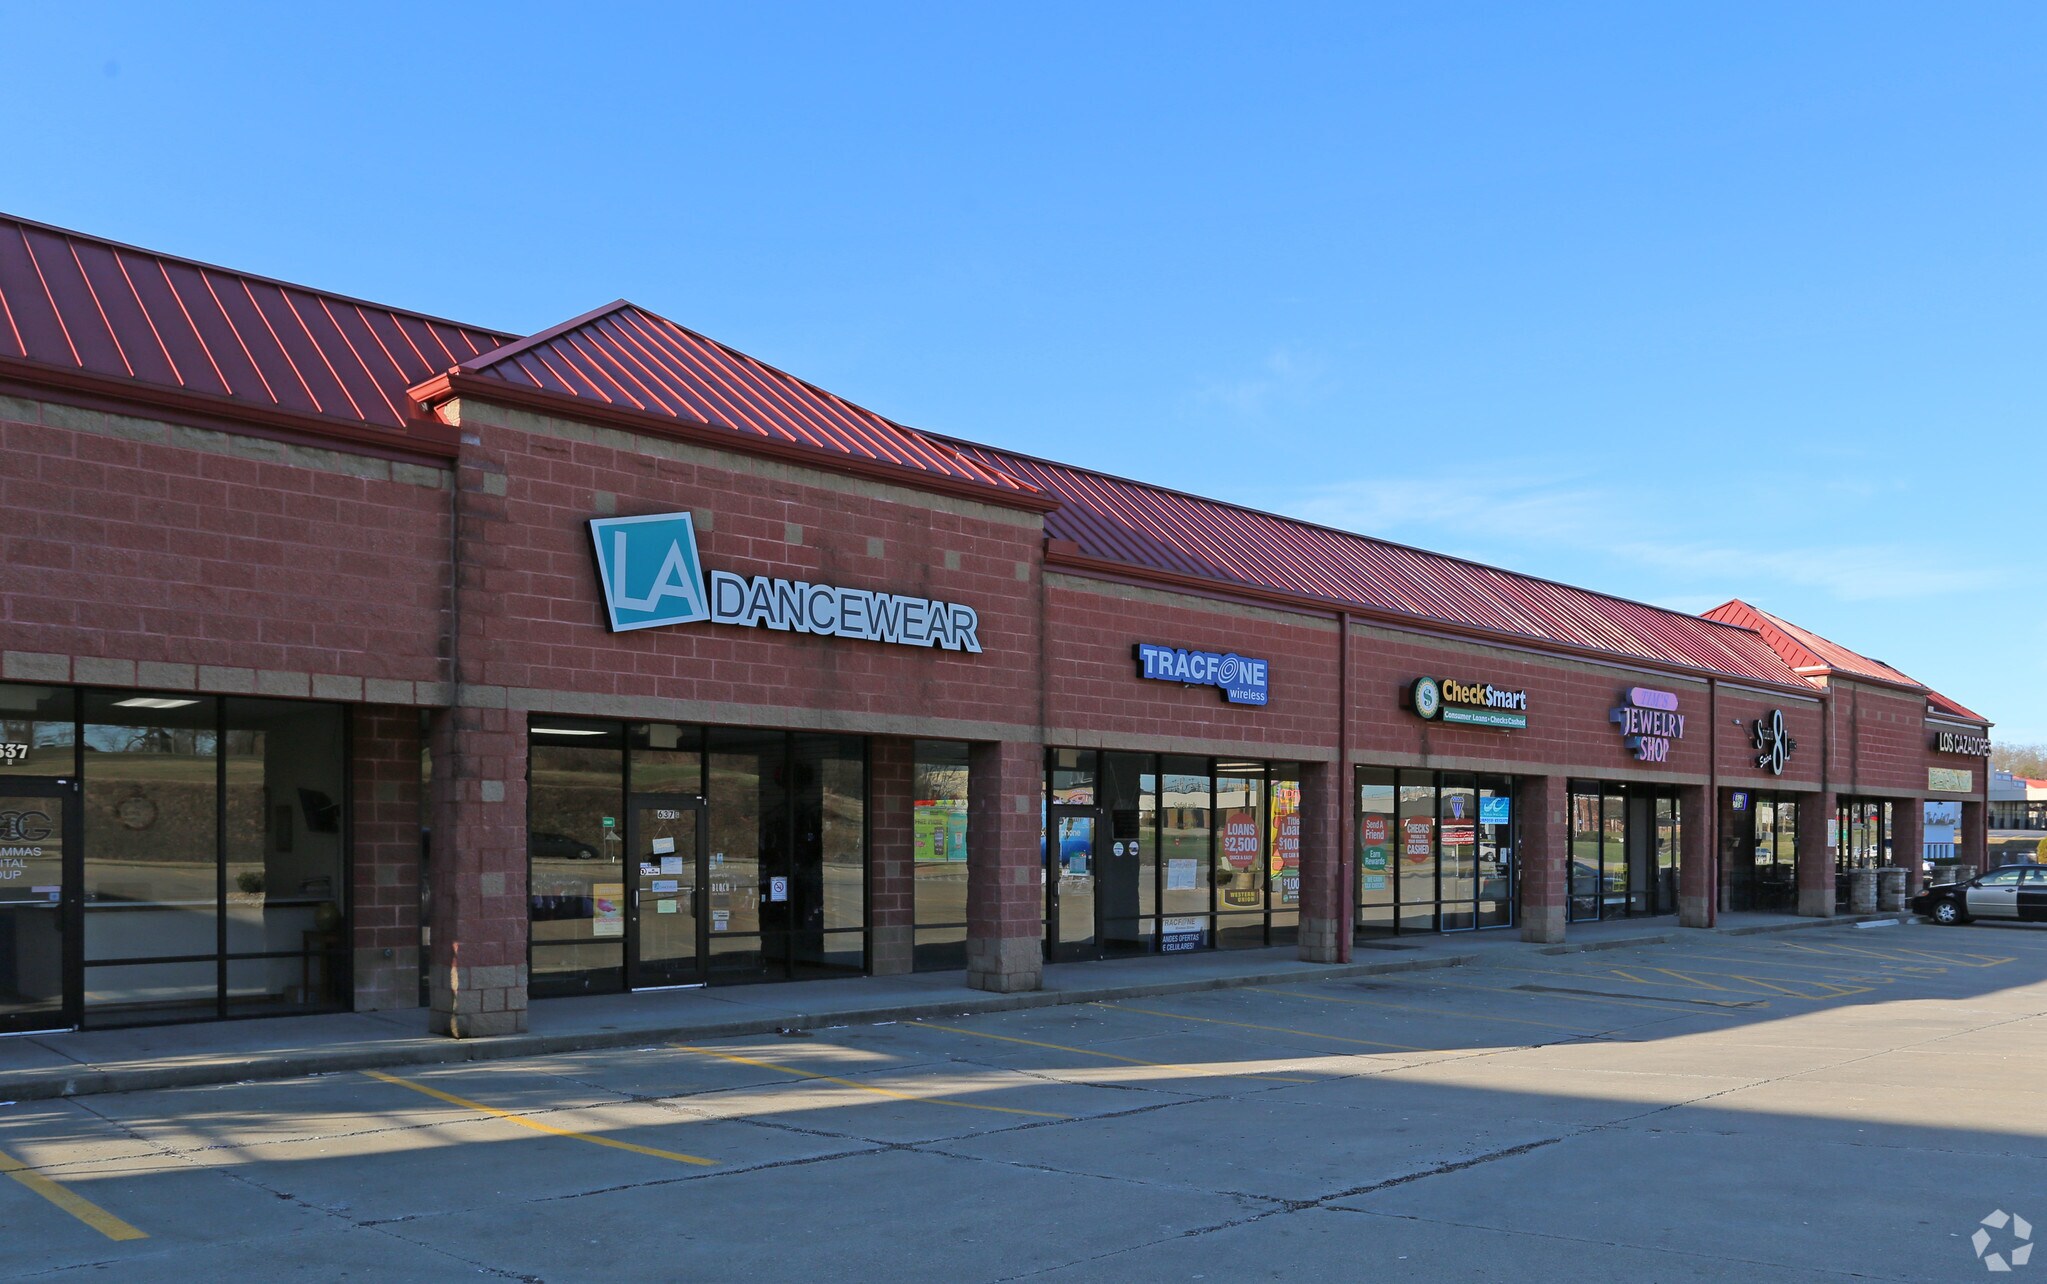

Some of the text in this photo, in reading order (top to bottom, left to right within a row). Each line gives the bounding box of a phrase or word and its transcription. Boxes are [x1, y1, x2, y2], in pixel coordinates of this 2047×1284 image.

[612, 530, 980, 651] LA DANCEWEAR
[1143, 648, 1265, 686] TRACFONE
[1229, 688, 1265, 701] wireless
[1444, 710, 1472, 721] Consumer
[1472, 713, 1488, 722] Loans
[1623, 707, 1685, 739] JEWELRY
[1639, 736, 1670, 762] SHOP
[1939, 731, 1993, 757] LOS CAZADORES
[1227, 823, 1255, 836] LOANS
[1366, 820, 1380, 829] Send
[1406, 823, 1430, 834] CHECKS
[1365, 829, 1385, 840] Friend
[1224, 837, 1258, 854] $2,500
[1406, 844, 1430, 855] CASHED
[0, 846, 42, 857] MMAS
[0, 858, 27, 868] ITAL
[1364, 857, 1385, 865] Rewards
[1162, 933, 1200, 943] ANDES OFERTAS
[1166, 943, 1195, 951] CELULARES!
